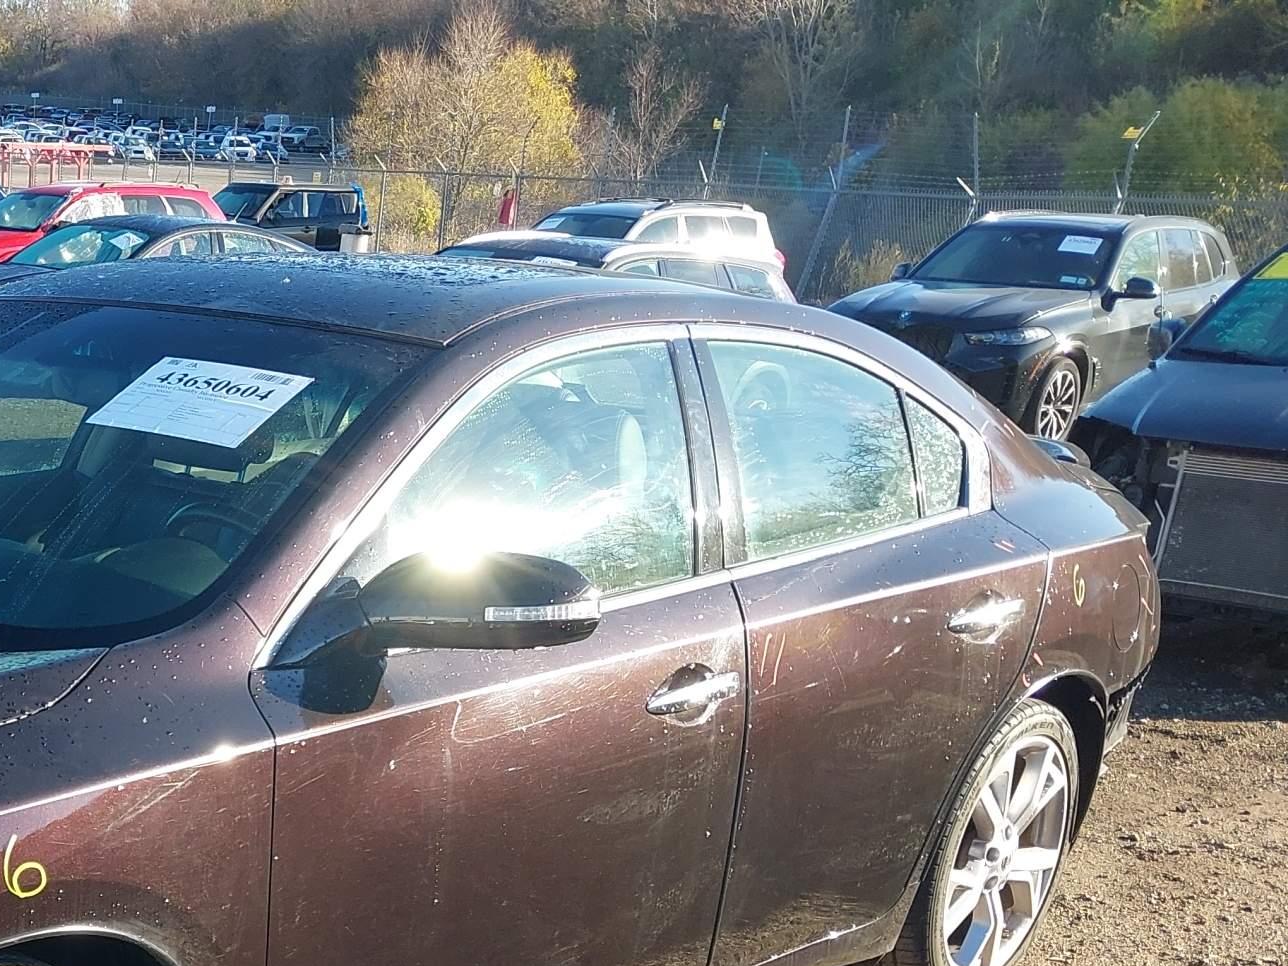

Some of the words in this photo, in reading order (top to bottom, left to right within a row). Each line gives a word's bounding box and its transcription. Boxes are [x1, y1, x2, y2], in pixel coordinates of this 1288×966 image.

[156, 371, 275, 401] 43650604
[1072, 563, 1086, 608] 6
[4, 834, 47, 898] 6
